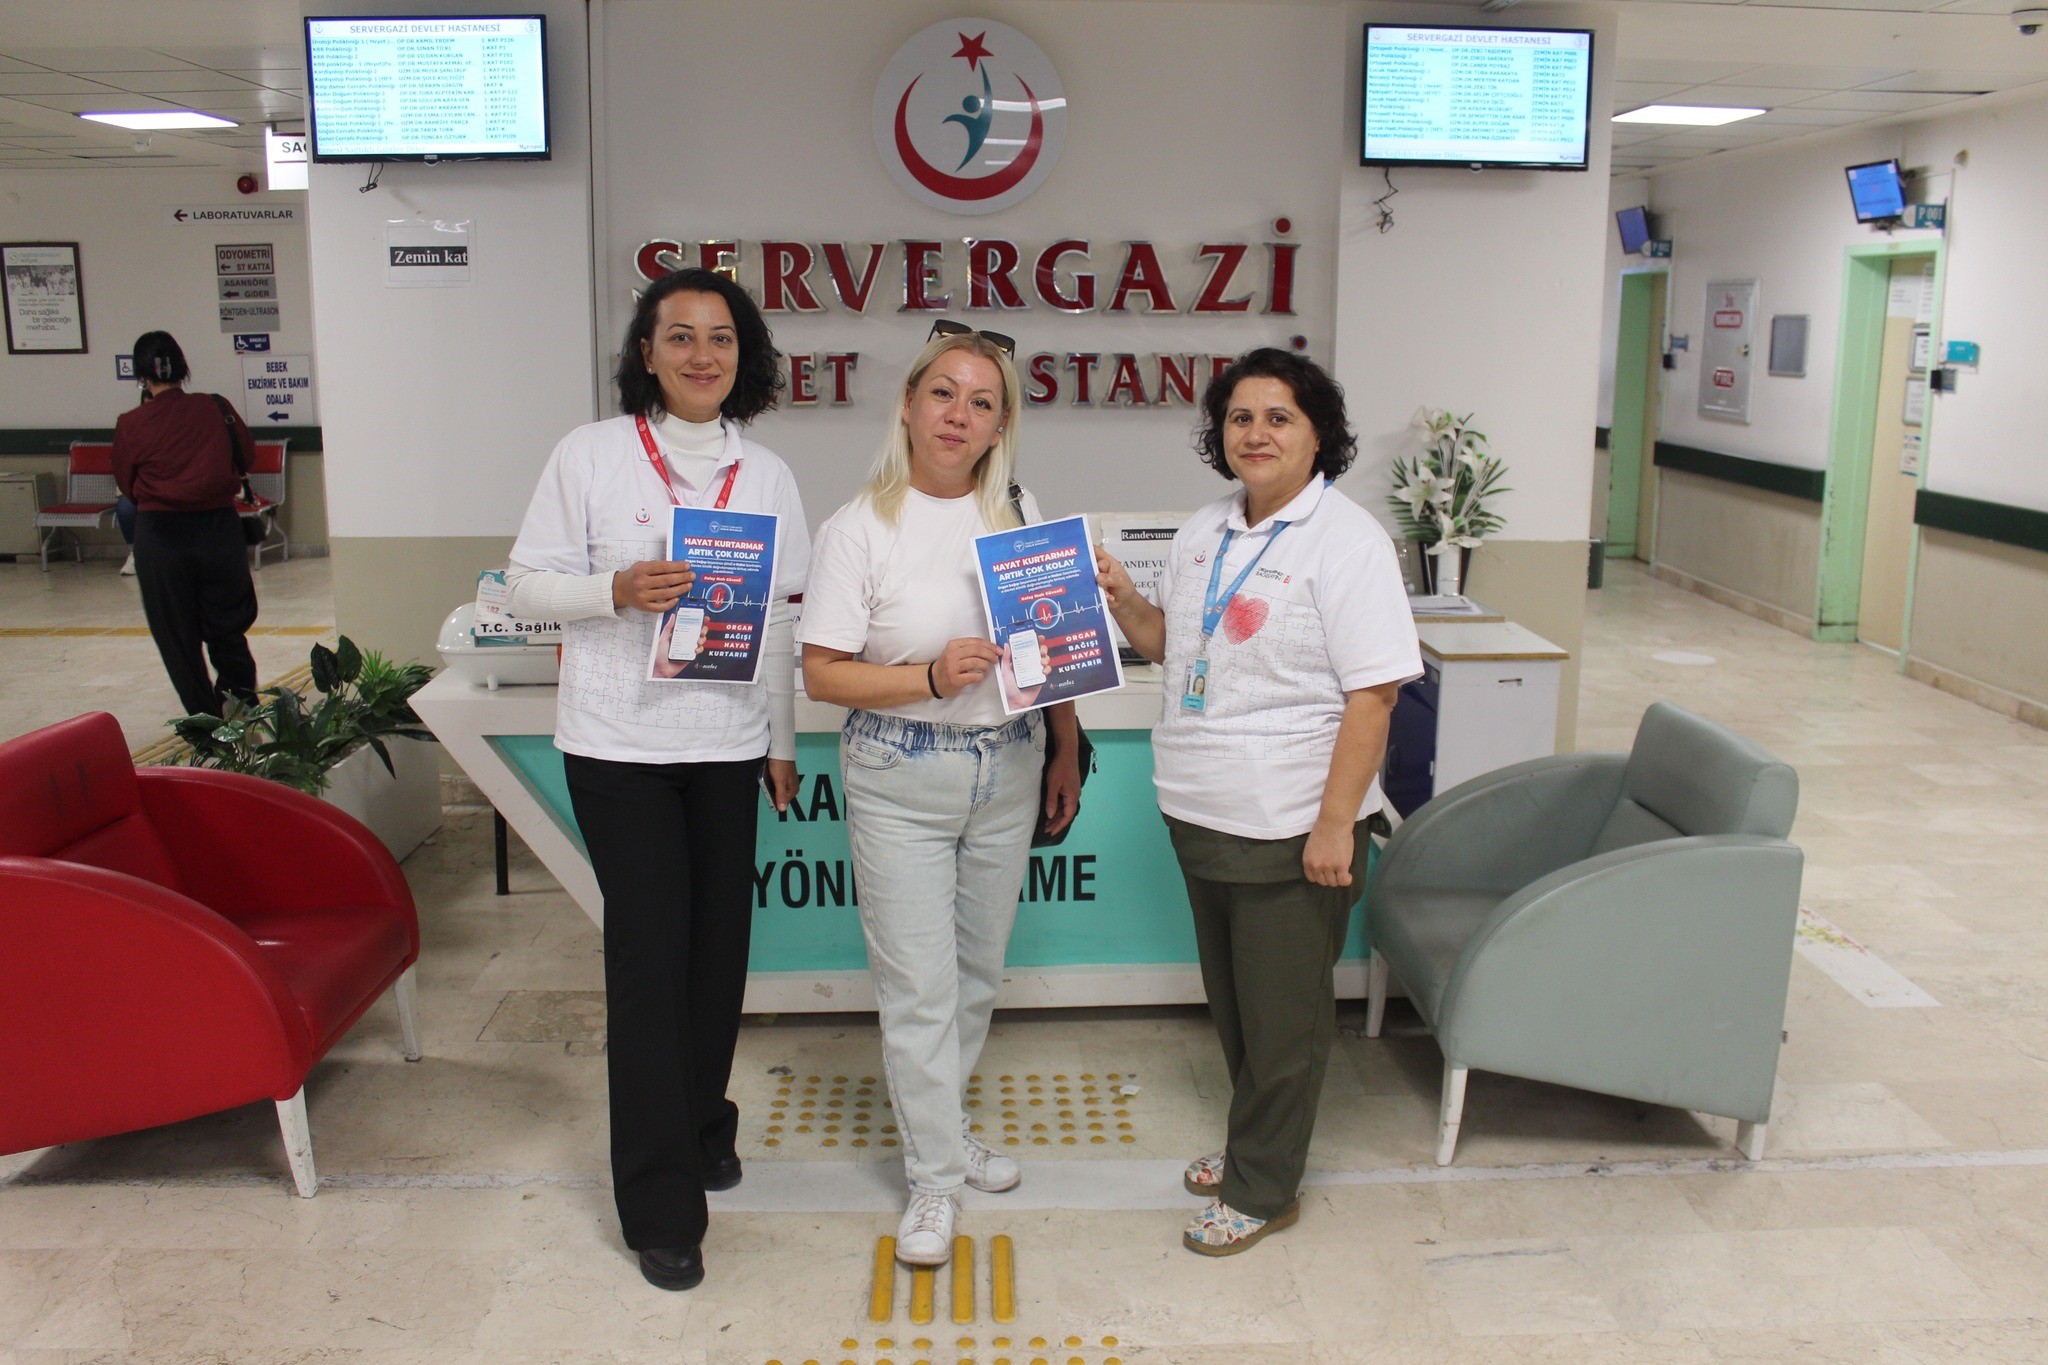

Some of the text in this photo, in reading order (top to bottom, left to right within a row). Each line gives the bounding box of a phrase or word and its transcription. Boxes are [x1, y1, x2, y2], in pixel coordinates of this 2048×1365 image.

[350, 24, 501, 34] SERVERGAZİ DEVLET HASTANESİ
[1407, 34, 1551, 44] SERVERGAZİ DEVLET HASTANESİ
[193, 210, 293, 220] LABORATUVARLAR
[219, 248, 271, 260] ODYOMETRİ
[394, 249, 469, 263] Zemin kat
[248, 263, 270, 271] KATTA
[224, 279, 269, 287] ASANSÖRE
[245, 290, 270, 298] GİDER
[266, 361, 288, 373] BEBEK
[248, 377, 309, 390] EMZİRME VE BAKIM
[266, 394, 293, 405] ODALARI
[685, 537, 764, 551] HAYAT KURTARMAK
[688, 548, 760, 560] ARTIK ÇOK KOLAY
[993, 548, 1077, 573] HAYAT KURTARMAK
[1118, 560, 1167, 569] ANDEVU
[999, 560, 1075, 583] ARTIK ÇOK KOLAY
[481, 622, 562, 634] T.C. Sağlık
[724, 633, 751, 641] BAĞIŞI
[1066, 630, 1097, 642] ORGAN
[1068, 640, 1098, 652] BAĞIŞI
[708, 650, 748, 658] KURTARIR
[1071, 649, 1101, 661] HAYAT
[1058, 658, 1102, 674] KURTARIR
[753, 849, 861, 911] YÖN
